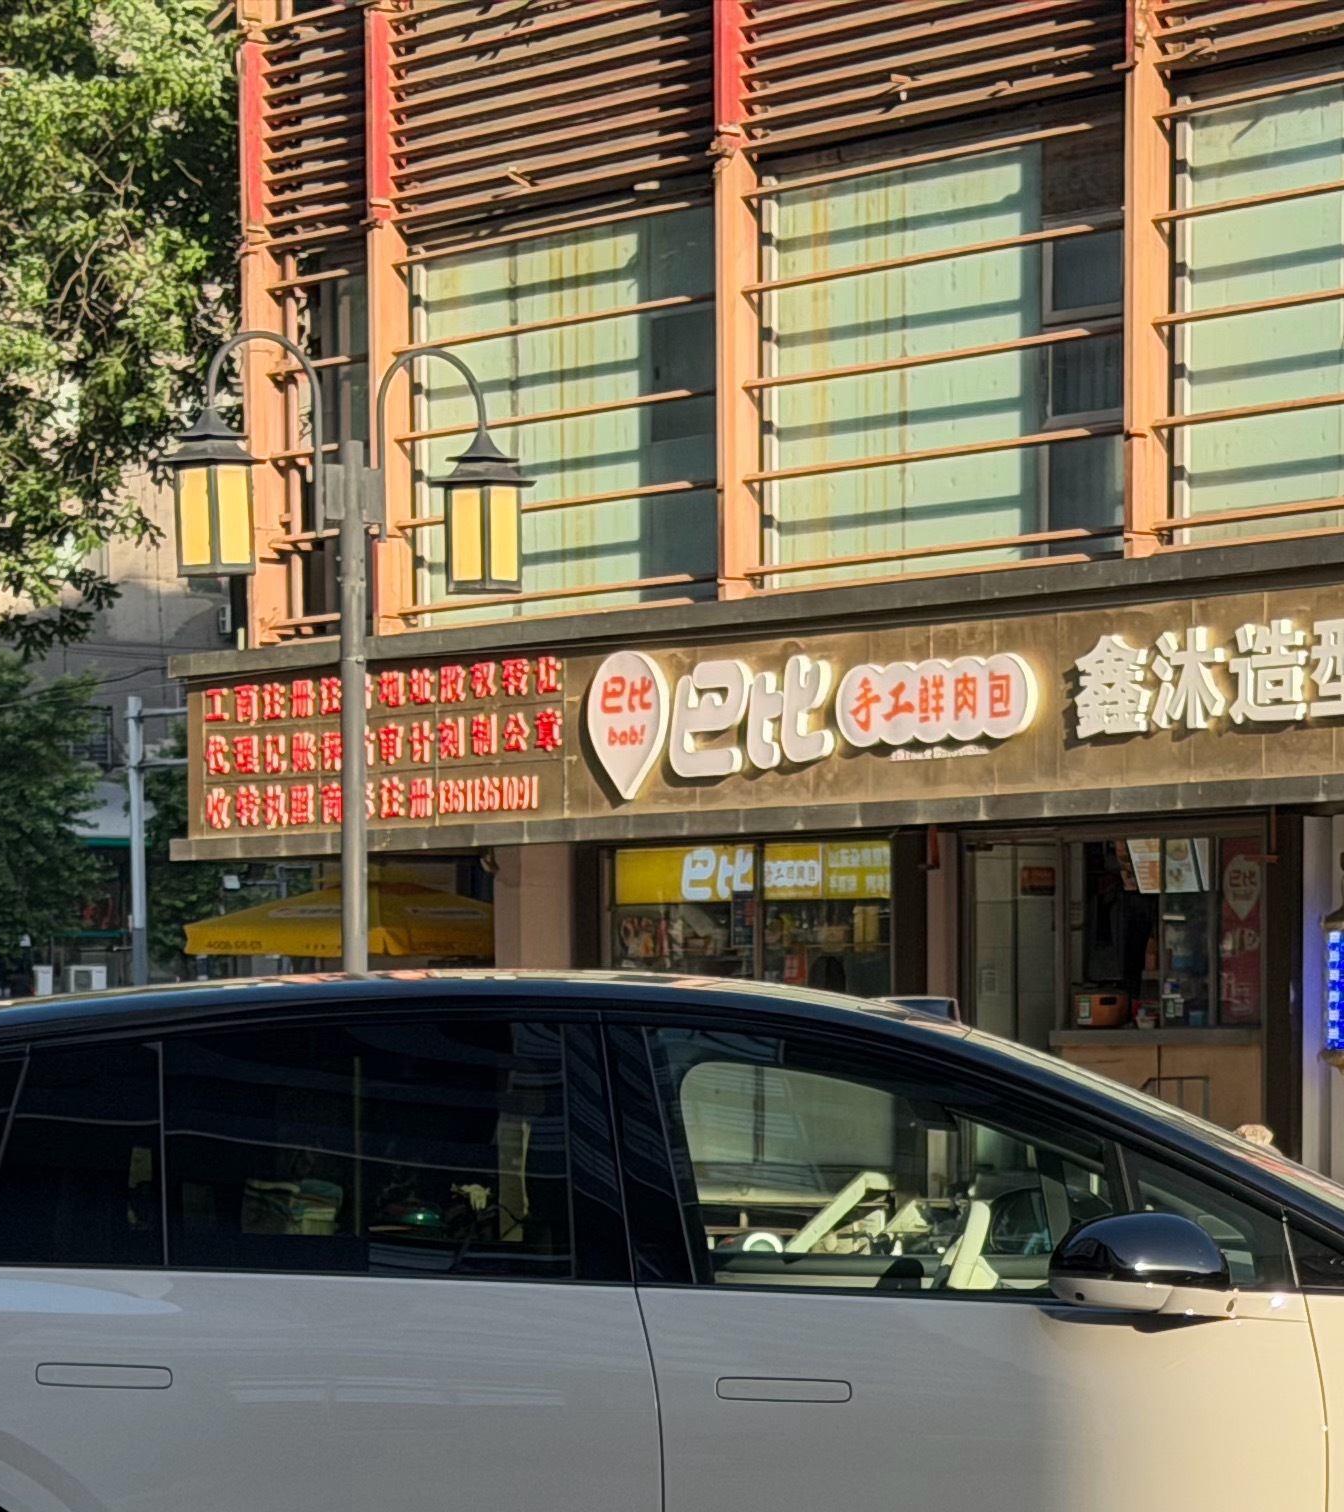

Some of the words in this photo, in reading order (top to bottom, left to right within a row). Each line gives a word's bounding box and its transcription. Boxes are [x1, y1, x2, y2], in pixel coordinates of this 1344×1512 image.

[205, 656, 563, 725] 工商注册注地址股权转让
[601, 676, 652, 714] 巴比
[670, 655, 834, 777] 巴比
[850, 671, 1012, 733] 手工鲜肉包
